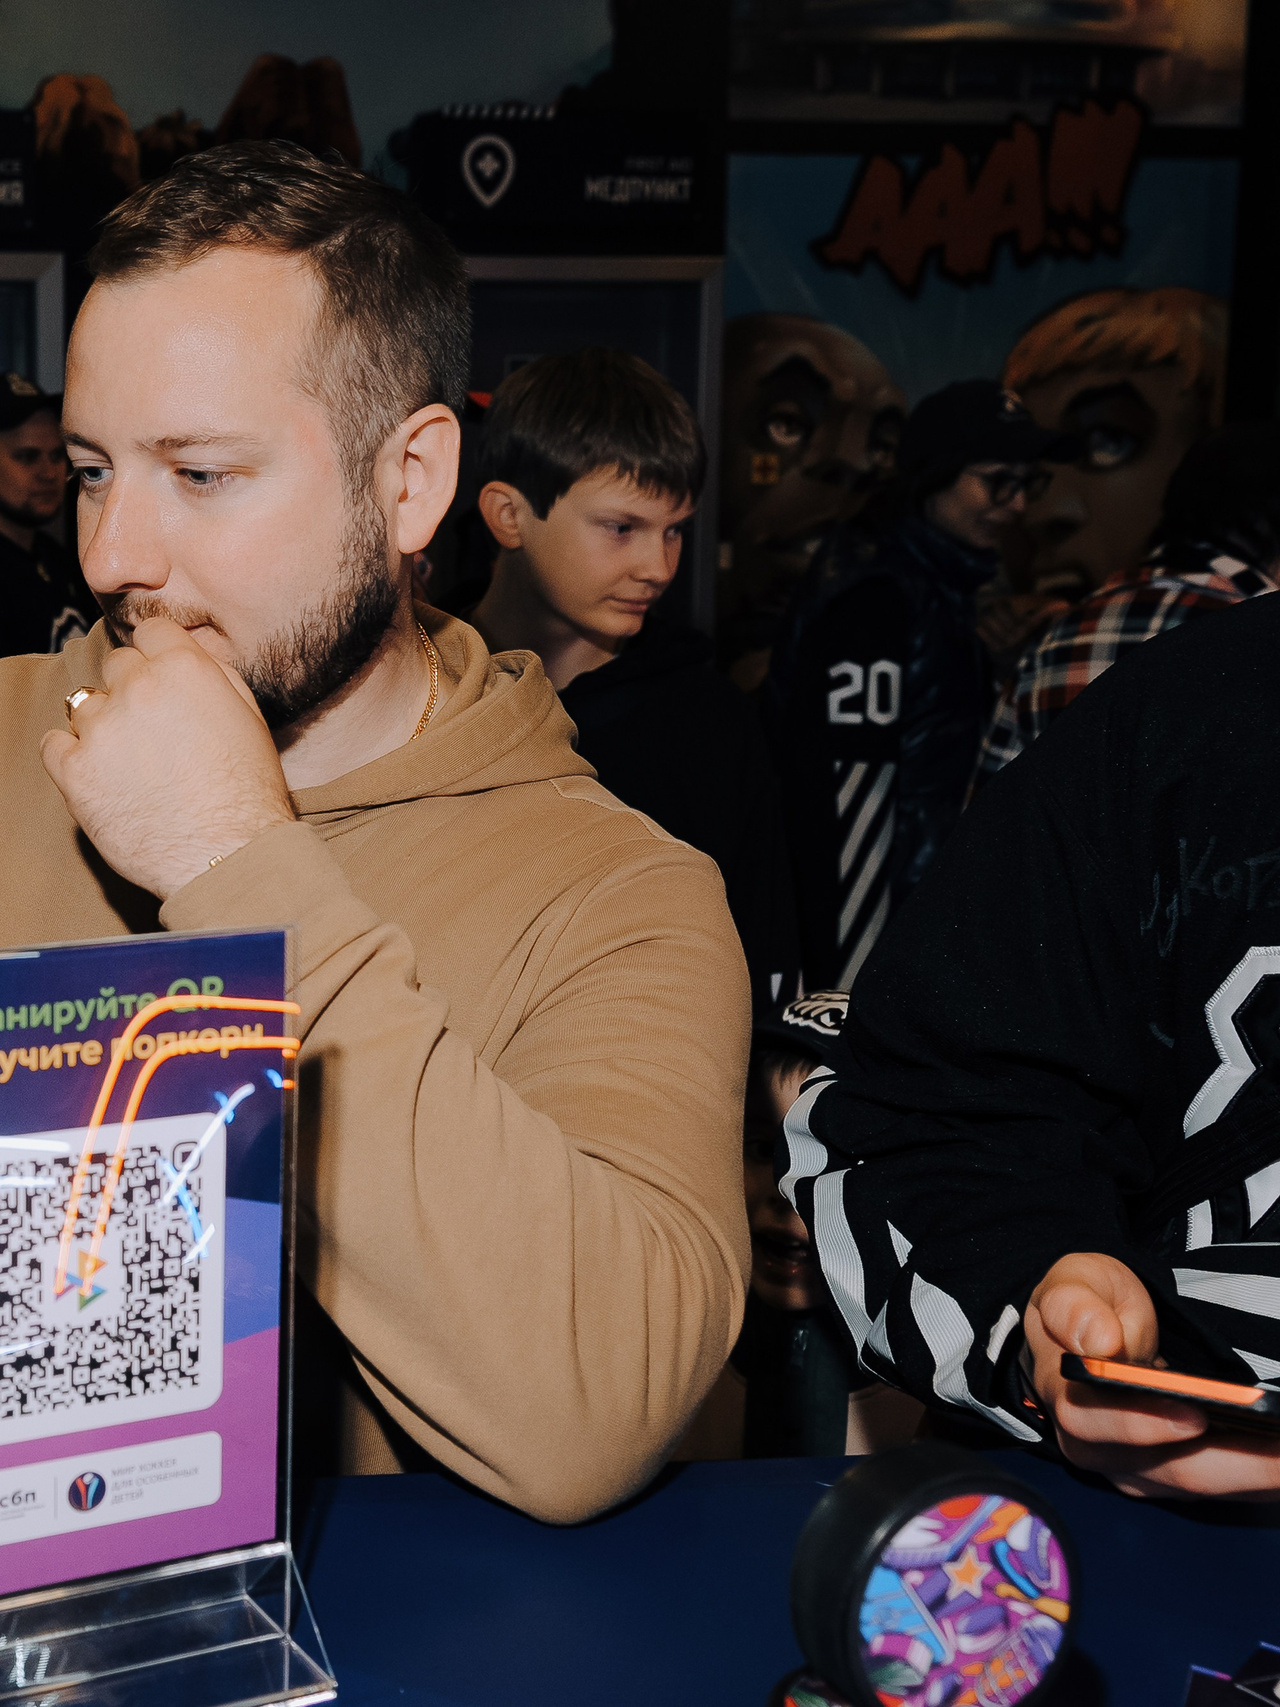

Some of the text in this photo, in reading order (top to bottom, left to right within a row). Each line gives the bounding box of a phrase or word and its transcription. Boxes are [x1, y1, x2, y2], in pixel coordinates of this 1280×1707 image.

[583, 175, 692, 205] МЕДПУНКТ
[827, 659, 902, 726] 20
[111, 1465, 136, 1477] МИР
[111, 1479, 134, 1492] ДЛЯ
[0, 1489, 36, 1508] сбп
[111, 1488, 144, 1506] ДЕТЕЙ
